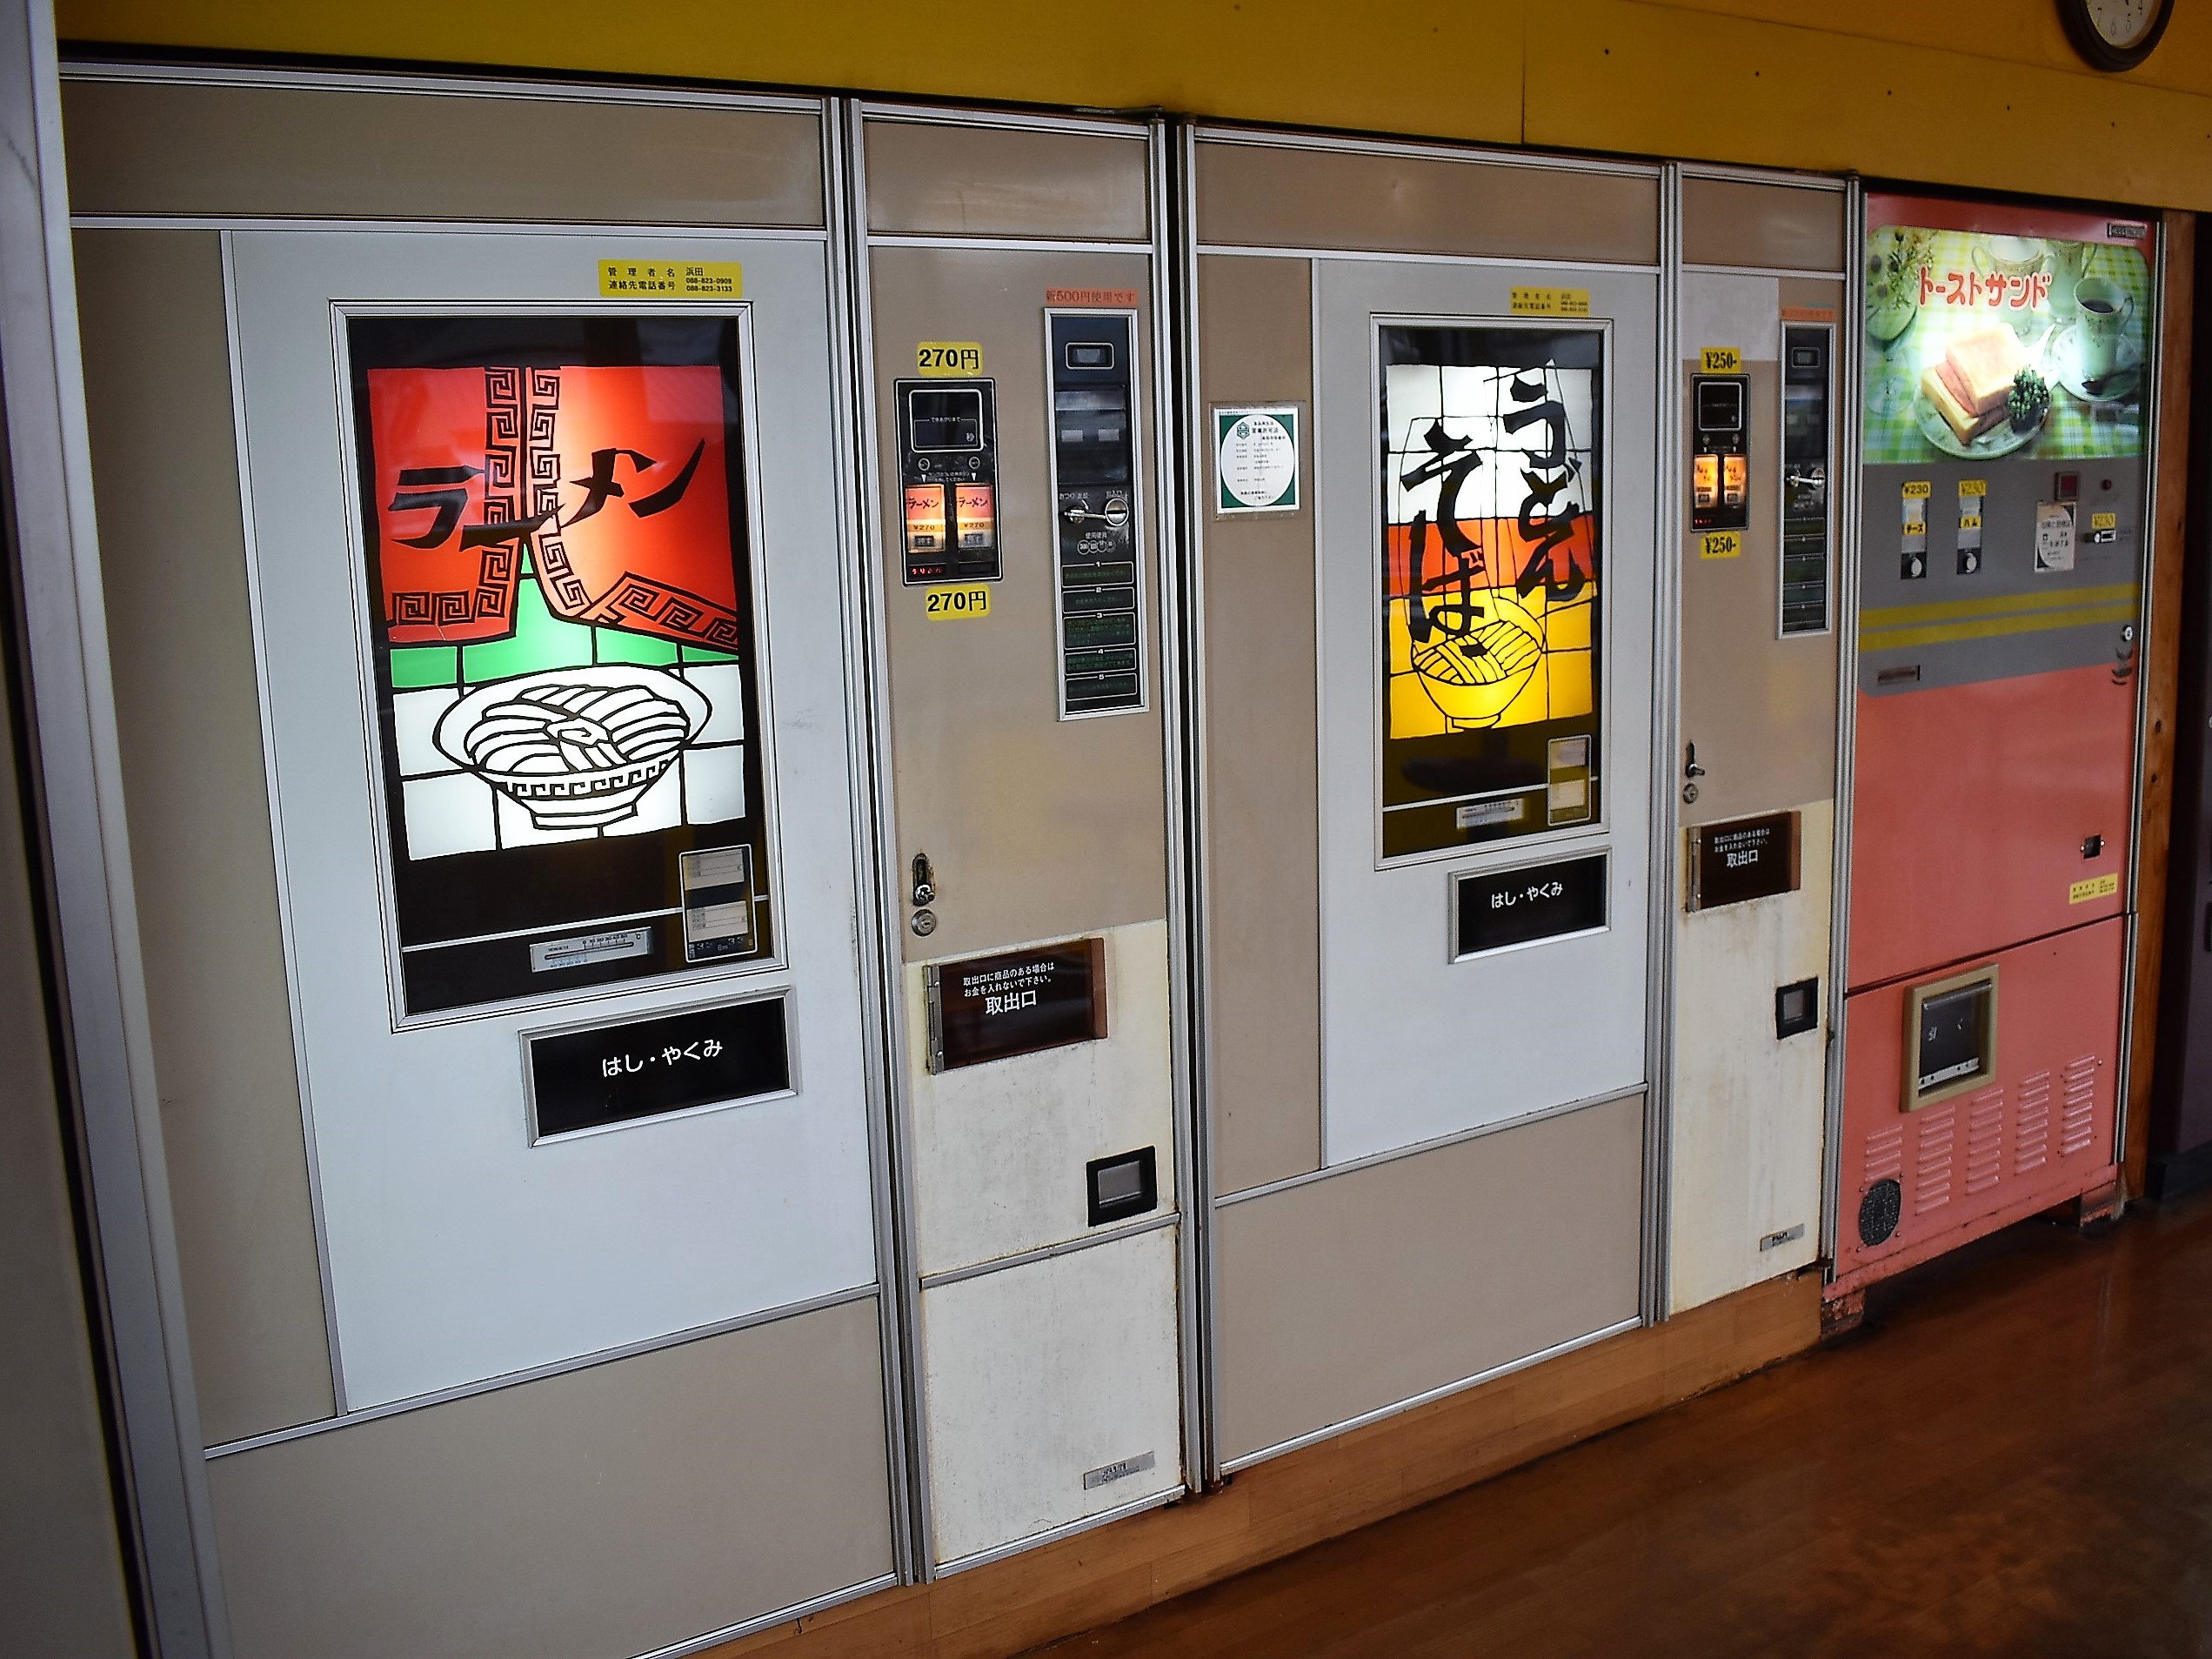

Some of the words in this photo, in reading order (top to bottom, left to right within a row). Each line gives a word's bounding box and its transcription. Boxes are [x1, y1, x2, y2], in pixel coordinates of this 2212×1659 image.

[608, 267, 675, 278] 管理者名
[685, 267, 704, 277] 浜田
[609, 280, 676, 291] 連絡先電話番号
[1920, 265, 2052, 308] トーストサンド
[919, 348, 979, 370] 270円
[389, 438, 705, 552] ラーメン
[1503, 374, 1583, 600] うどん
[908, 497, 939, 510] ラーメン
[959, 497, 988, 508] ラーメン
[1400, 418, 1485, 644] そば
[926, 590, 986, 612] 270円
[1727, 849, 1759, 867] 取出口
[1491, 881, 1564, 909] はし・やくみ
[963, 961, 1055, 987] 取出口に商品のある場合は
[964, 975, 1052, 997] お金を入れないで下さい。
[985, 990, 1037, 1015] 取出口
[602, 1039, 723, 1078] はし・やくみ
